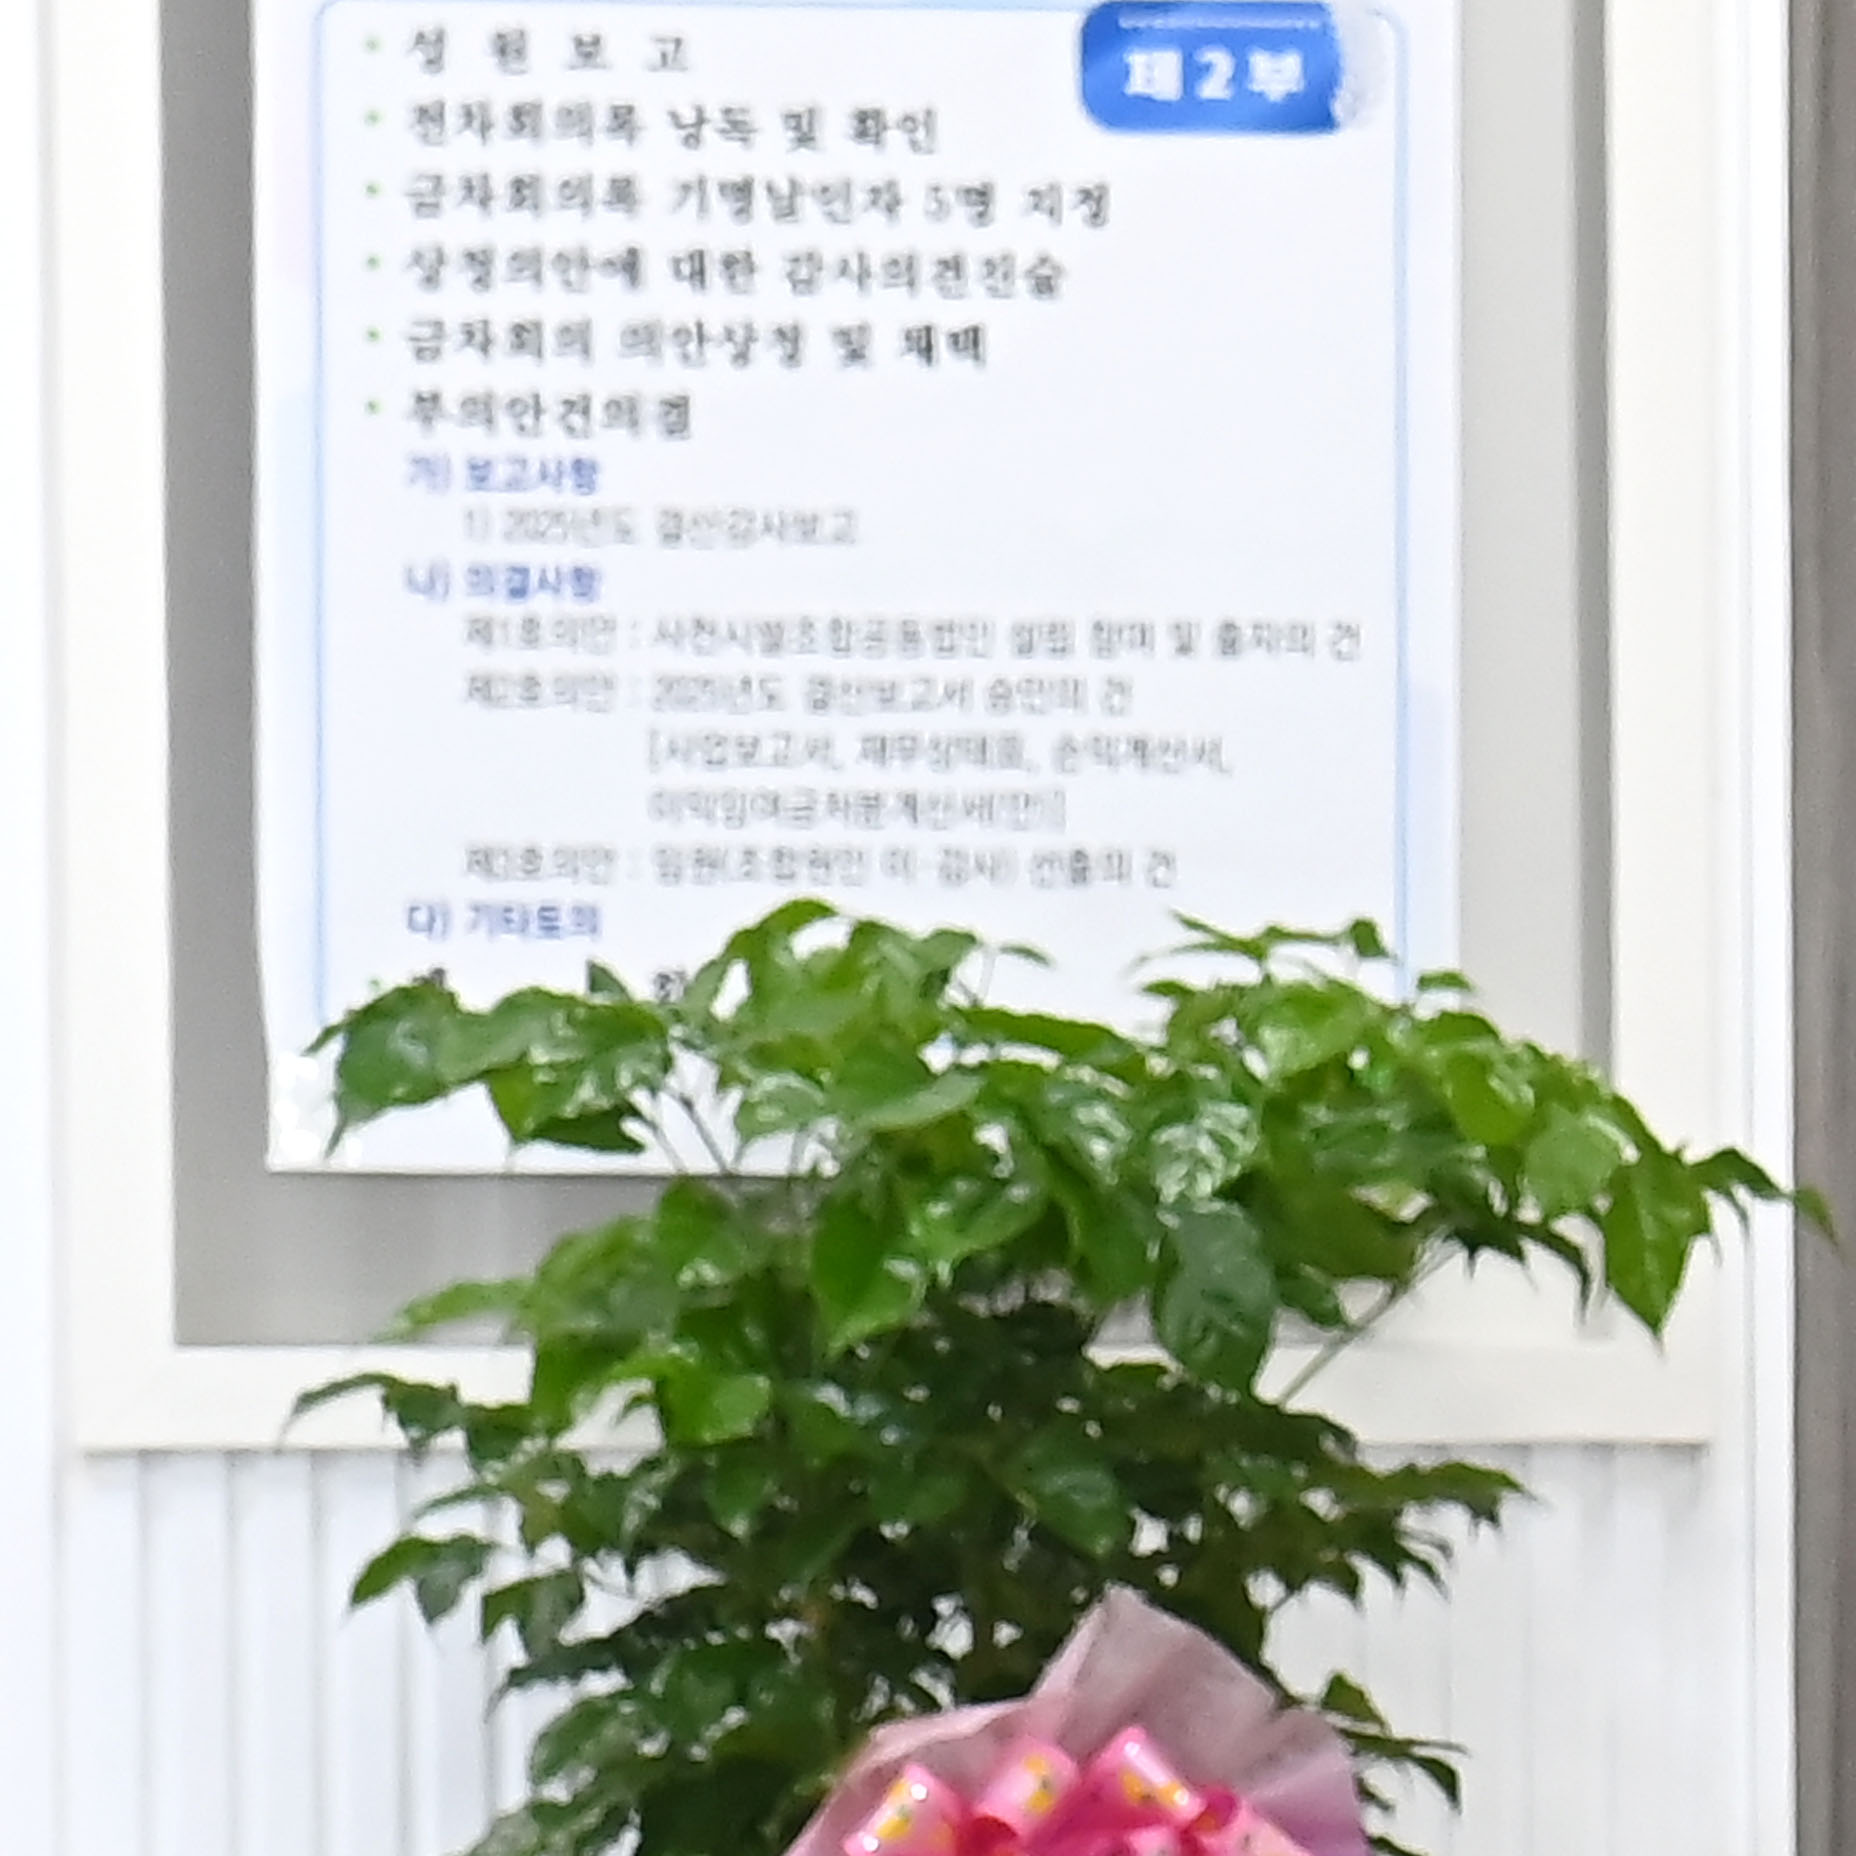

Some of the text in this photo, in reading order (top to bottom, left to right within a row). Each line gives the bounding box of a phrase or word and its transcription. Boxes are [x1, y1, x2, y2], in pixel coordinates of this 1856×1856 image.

[1123, 48, 1304, 102] 제2부
[416, 102, 932, 151] 전차회의록 낭독 및 확인
[411, 174, 1107, 227] 금차회의록 기명날인자 5명 지정
[412, 247, 1061, 298] 상정의안에 대한 감사의견진술
[409, 319, 984, 367] 금차회의 의안상정 및 채택
[414, 392, 689, 438] 부의안건의결
[465, 456, 601, 496] 보고사항
[466, 563, 602, 604] 의결사항
